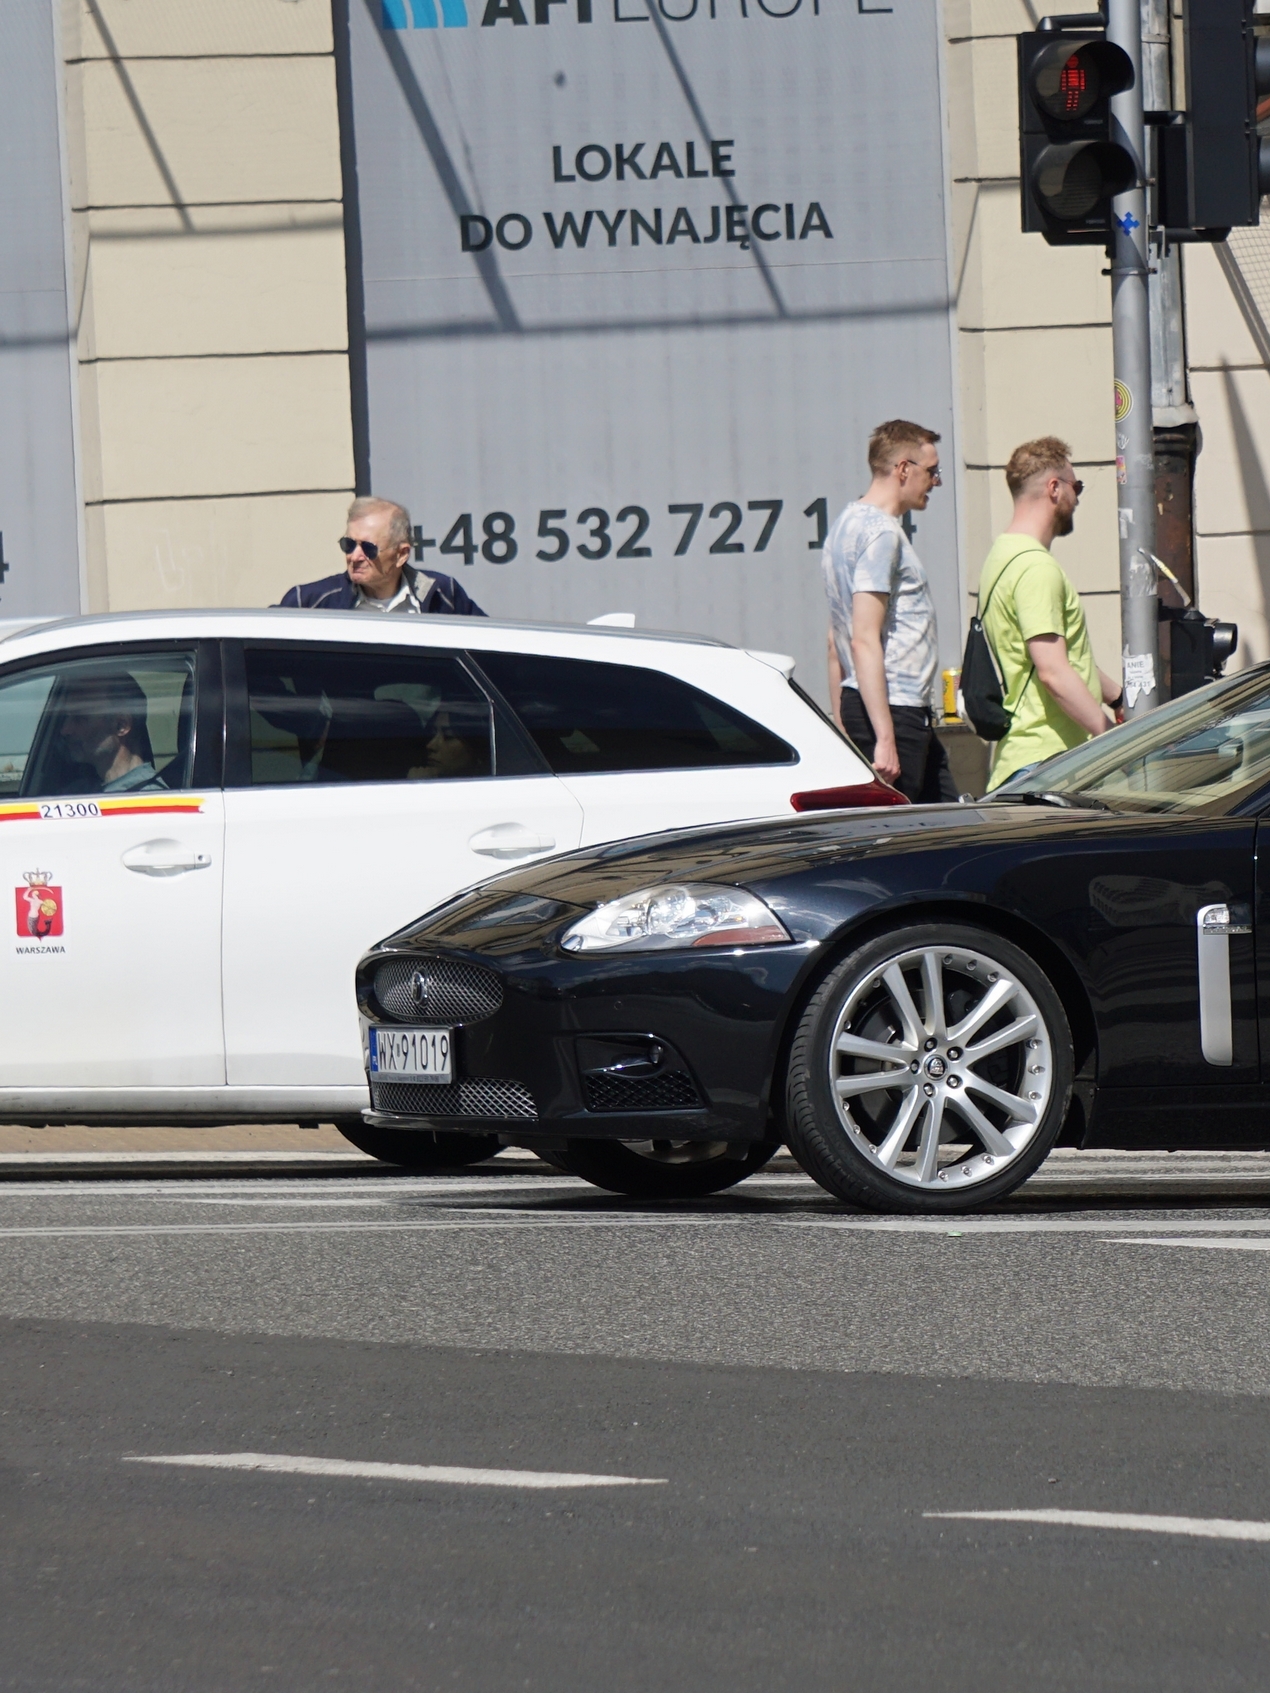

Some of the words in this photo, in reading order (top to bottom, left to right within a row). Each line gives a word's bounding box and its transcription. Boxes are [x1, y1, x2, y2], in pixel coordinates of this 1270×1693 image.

[552, 139, 736, 183] LOKALE
[459, 213, 533, 253] DO
[543, 202, 834, 251] WYNAJĘCIA
[411, 511, 518, 567] +48
[535, 505, 653, 562] 532
[667, 499, 784, 556] 727
[41, 803, 98, 819] 21300
[16, 945, 66, 955] WARSZAWA
[377, 1032, 398, 1071] WX
[401, 1033, 449, 1072] 91019
